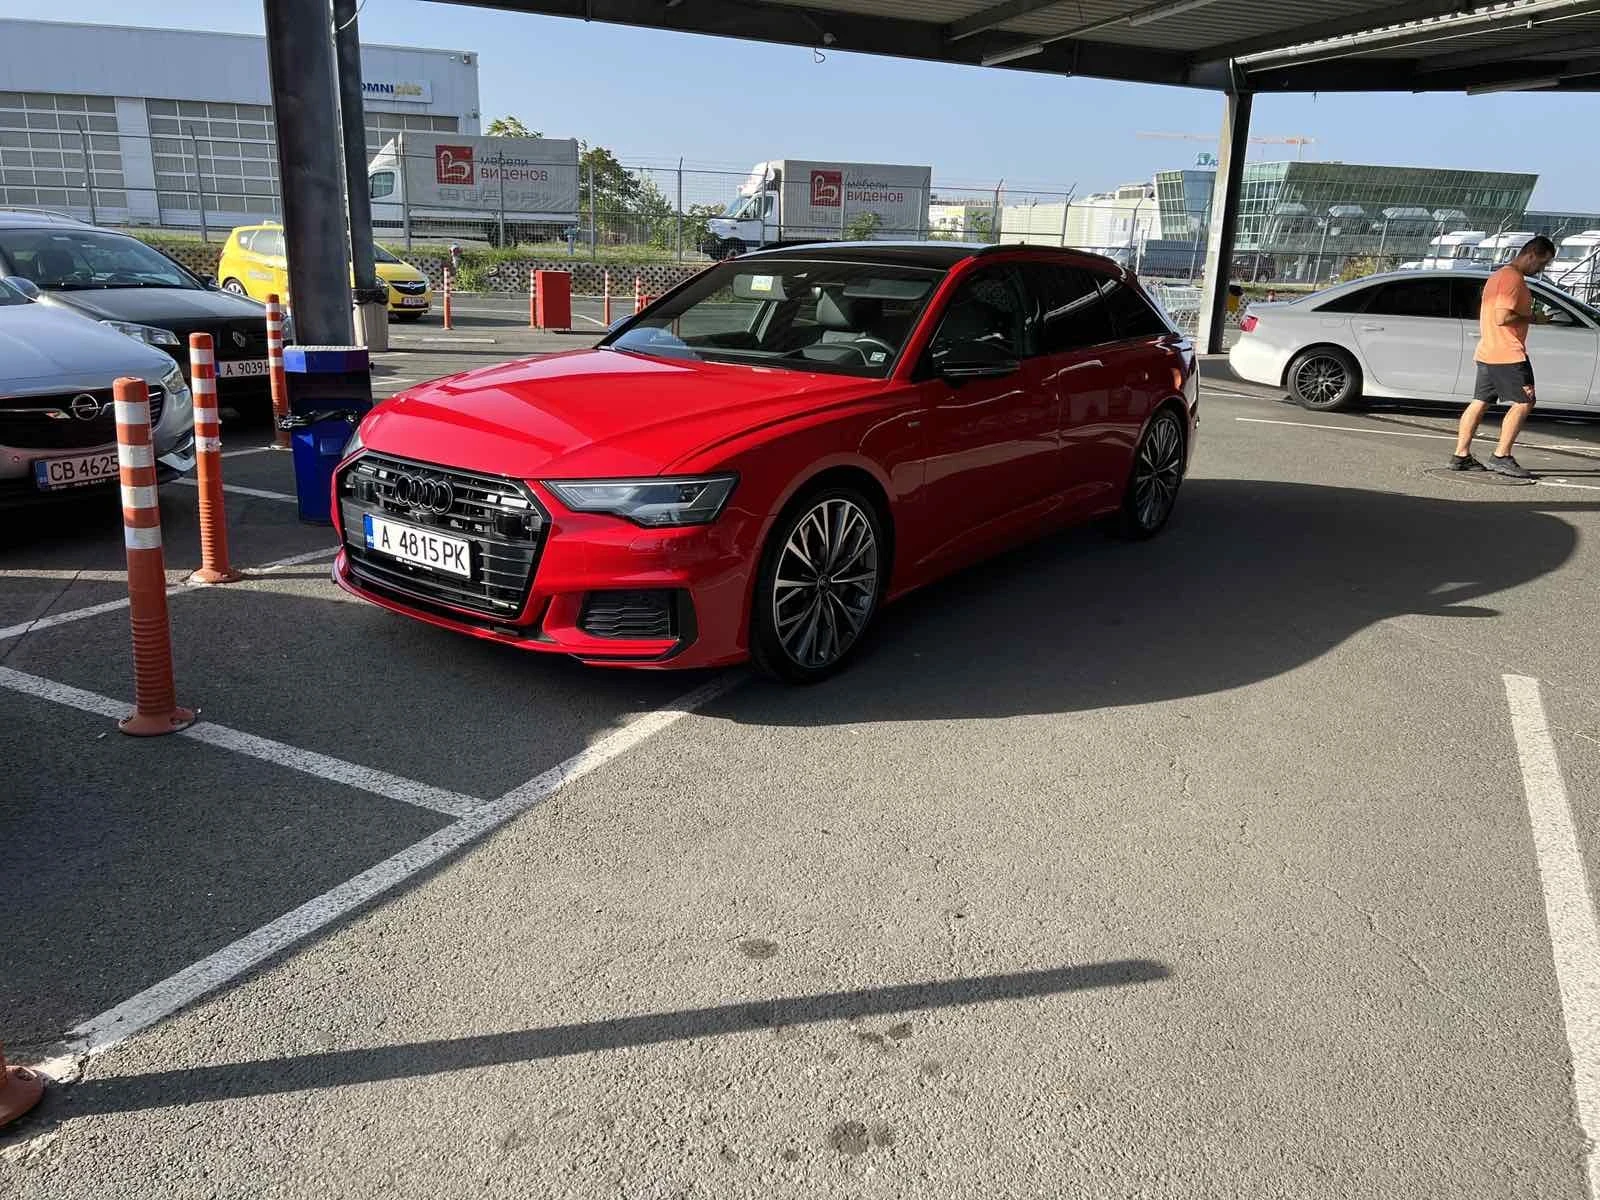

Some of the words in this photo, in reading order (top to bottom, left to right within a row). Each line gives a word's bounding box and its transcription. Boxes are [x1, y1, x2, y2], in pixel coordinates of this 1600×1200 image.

[480, 167, 549, 181] виденов
[226, 363, 233, 375] A
[238, 362, 263, 375] 9039
[50, 461, 75, 481] CB
[79, 454, 120, 477] 4625
[382, 525, 391, 549] A
